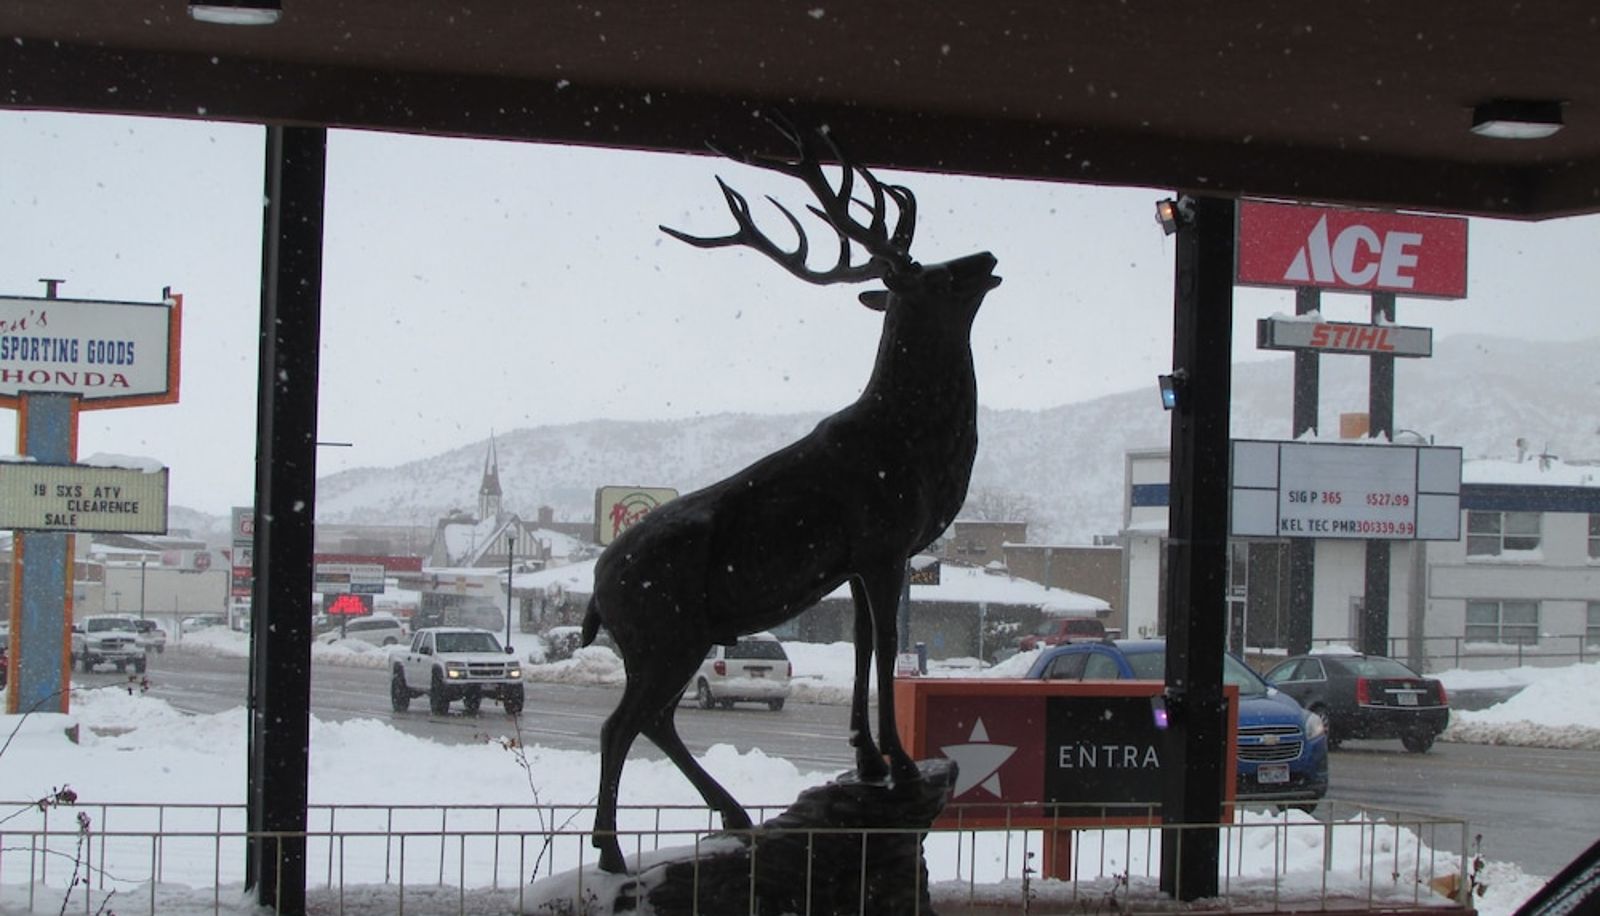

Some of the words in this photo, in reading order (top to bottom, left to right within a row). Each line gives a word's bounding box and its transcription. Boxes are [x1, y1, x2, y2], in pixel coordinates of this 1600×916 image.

[1284, 213, 1423, 288] ACE
[1309, 323, 1394, 351] STIHL
[1, 336, 78, 363] SPORTING
[87, 340, 135, 366] GOODS
[1, 369, 130, 388] HONDA
[57, 485, 82, 498] SXS
[94, 486, 121, 499] ATV
[1288, 490, 1307, 503] SIG
[1310, 491, 1318, 504] P
[1321, 491, 1342, 505] 365
[67, 500, 139, 514] CLEARENCE
[45, 514, 77, 526] SALE
[1281, 518, 1303, 532] KEL
[1308, 519, 1329, 532] TEC
[1059, 745, 1160, 769] ENTRA
